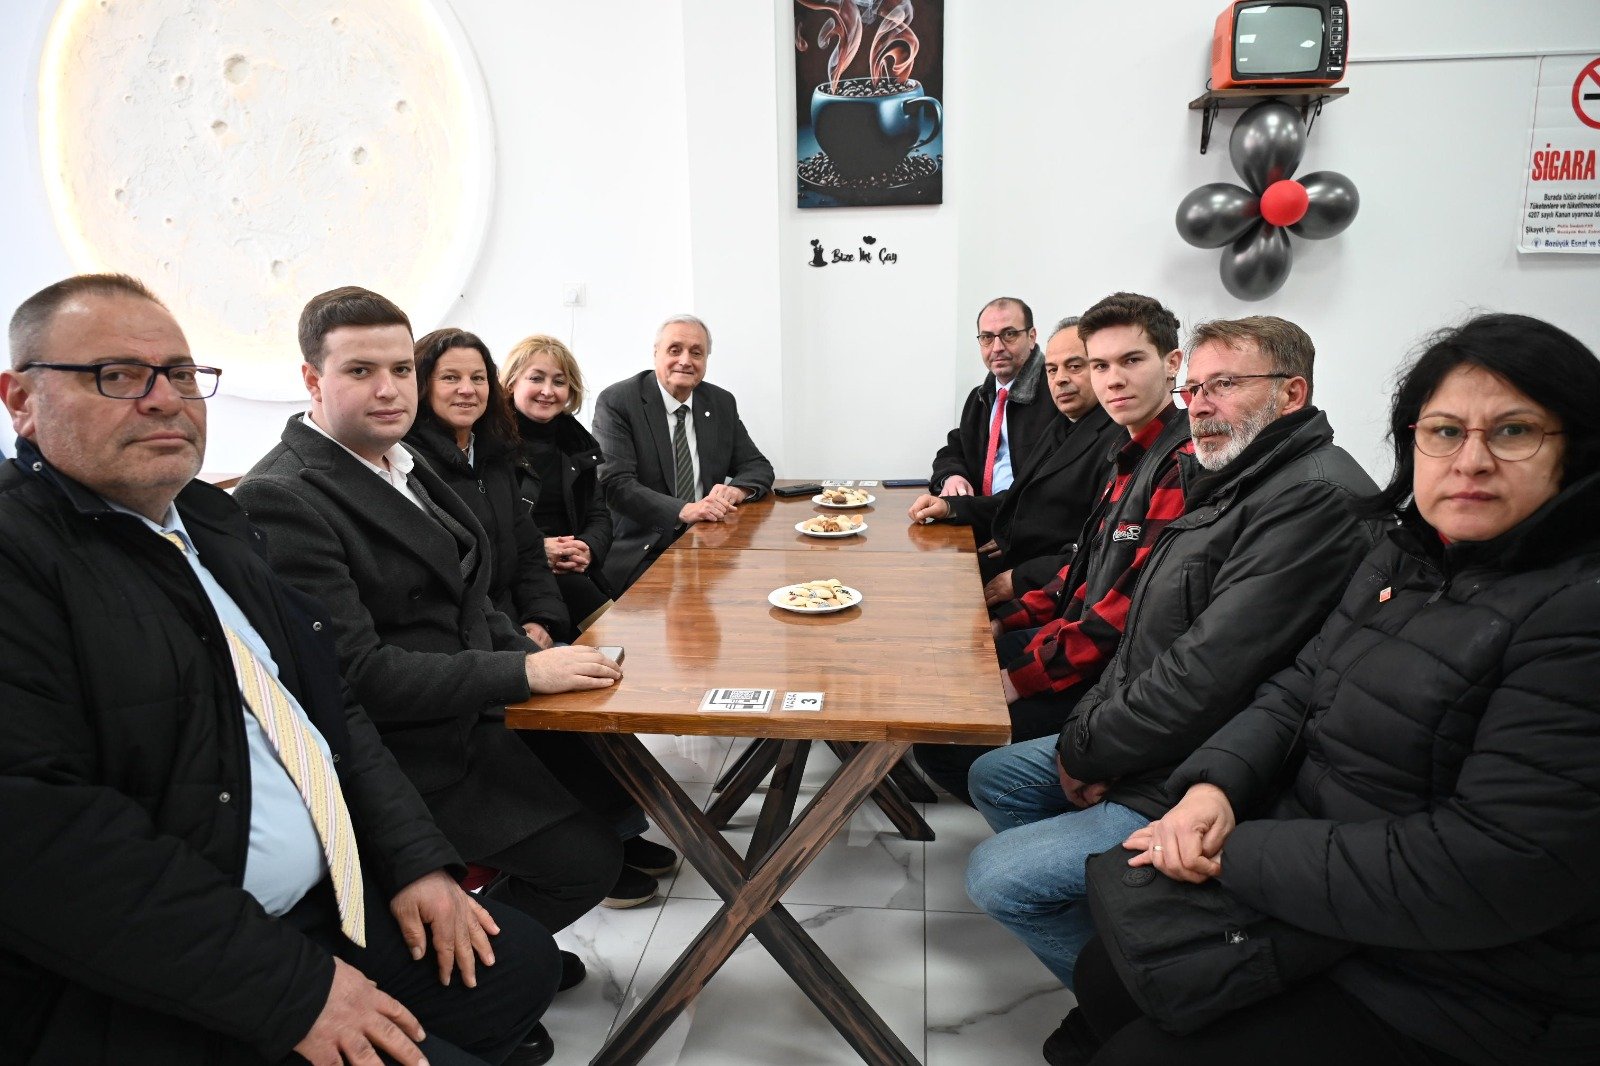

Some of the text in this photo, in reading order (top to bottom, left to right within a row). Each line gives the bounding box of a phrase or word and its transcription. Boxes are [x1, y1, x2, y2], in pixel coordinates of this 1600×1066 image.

[1532, 143, 1595, 181] SİGARA
[1544, 193, 1562, 201] Burada
[1563, 193, 1576, 201] tütün
[1577, 192, 1597, 200] ürünleri
[1541, 211, 1554, 219] sayılı
[1572, 211, 1593, 219] uyarınca
[1525, 226, 1556, 235] Şikayet için:
[1545, 239, 1569, 248] Bozüyük
[1571, 239, 1588, 247] Esnaf
[831, 248, 854, 264] Bize
[879, 247, 897, 265] Çay
